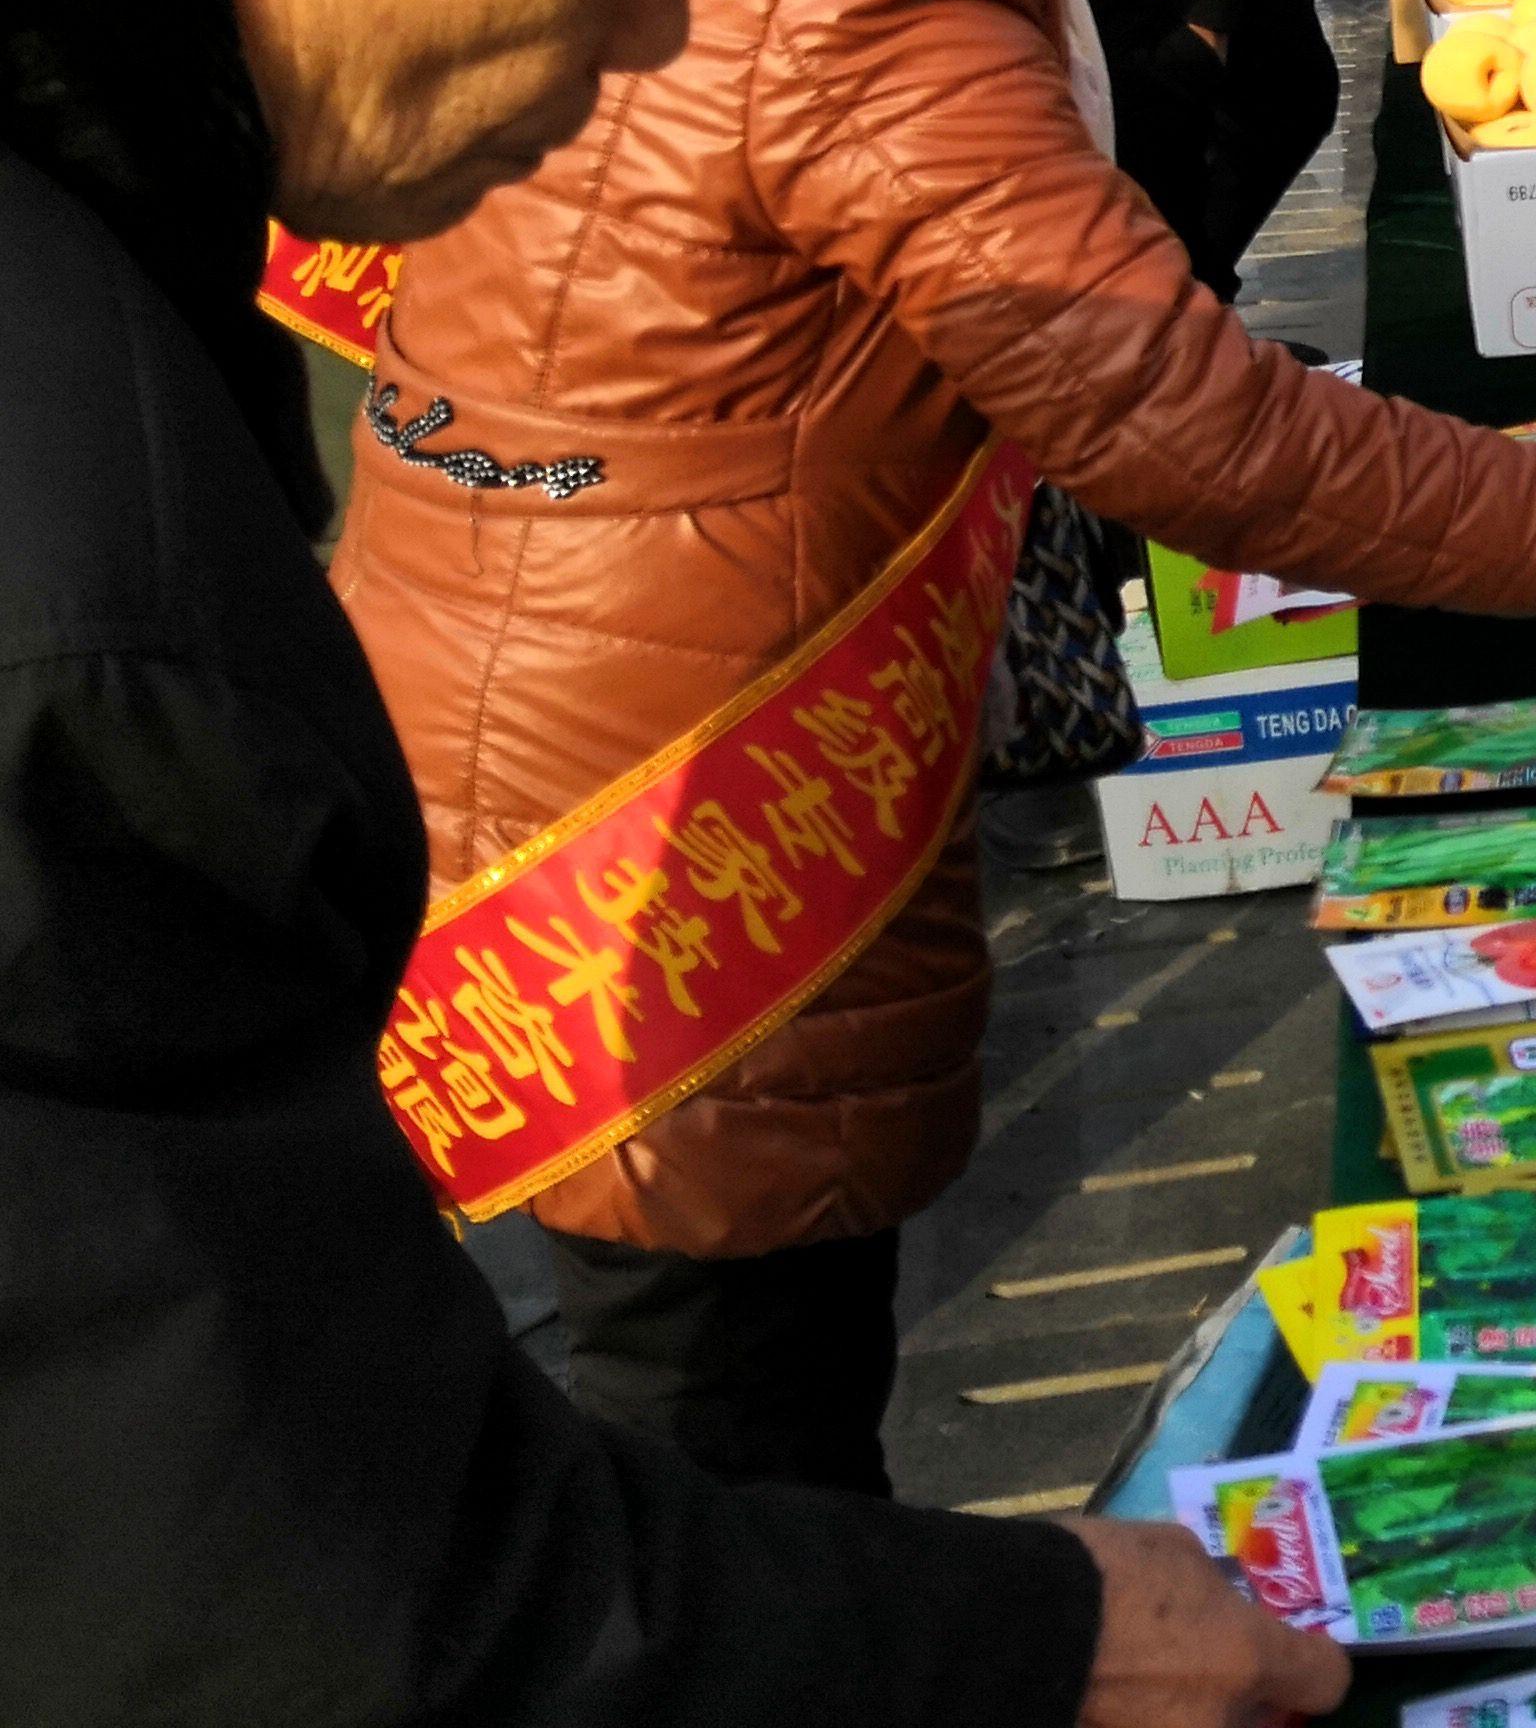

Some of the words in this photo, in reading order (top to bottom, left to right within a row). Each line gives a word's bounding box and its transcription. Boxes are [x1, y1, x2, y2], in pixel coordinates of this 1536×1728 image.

[1257, 711, 1310, 739] TENG
[1315, 707, 1342, 731] DA
[1138, 791, 1285, 847] AAA
